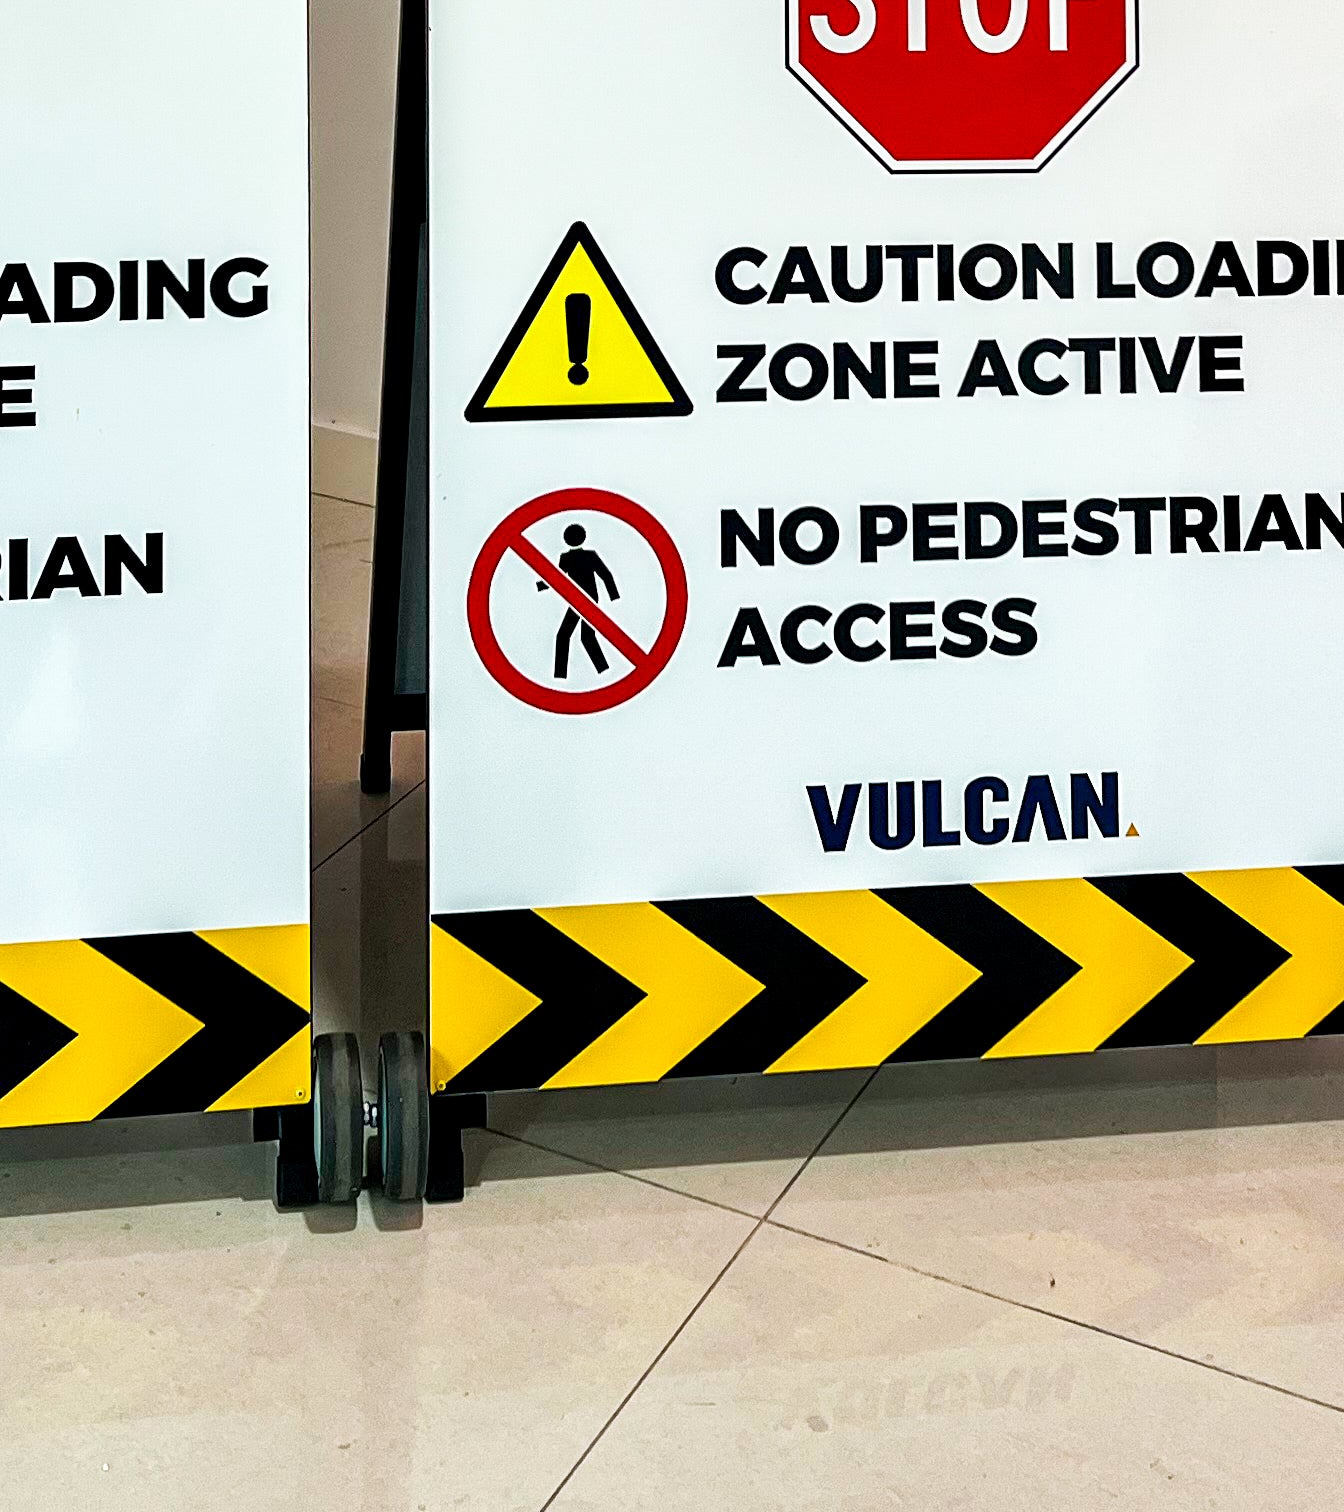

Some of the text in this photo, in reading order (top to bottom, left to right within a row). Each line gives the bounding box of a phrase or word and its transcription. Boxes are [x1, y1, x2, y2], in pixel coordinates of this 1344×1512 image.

[715, 243, 1074, 304] CAUTION
[716, 336, 1244, 402] ZONE ACTIVE
[721, 507, 839, 568] NO
[717, 598, 1037, 667] ACCESS
[806, 772, 1119, 852] VULCAN
